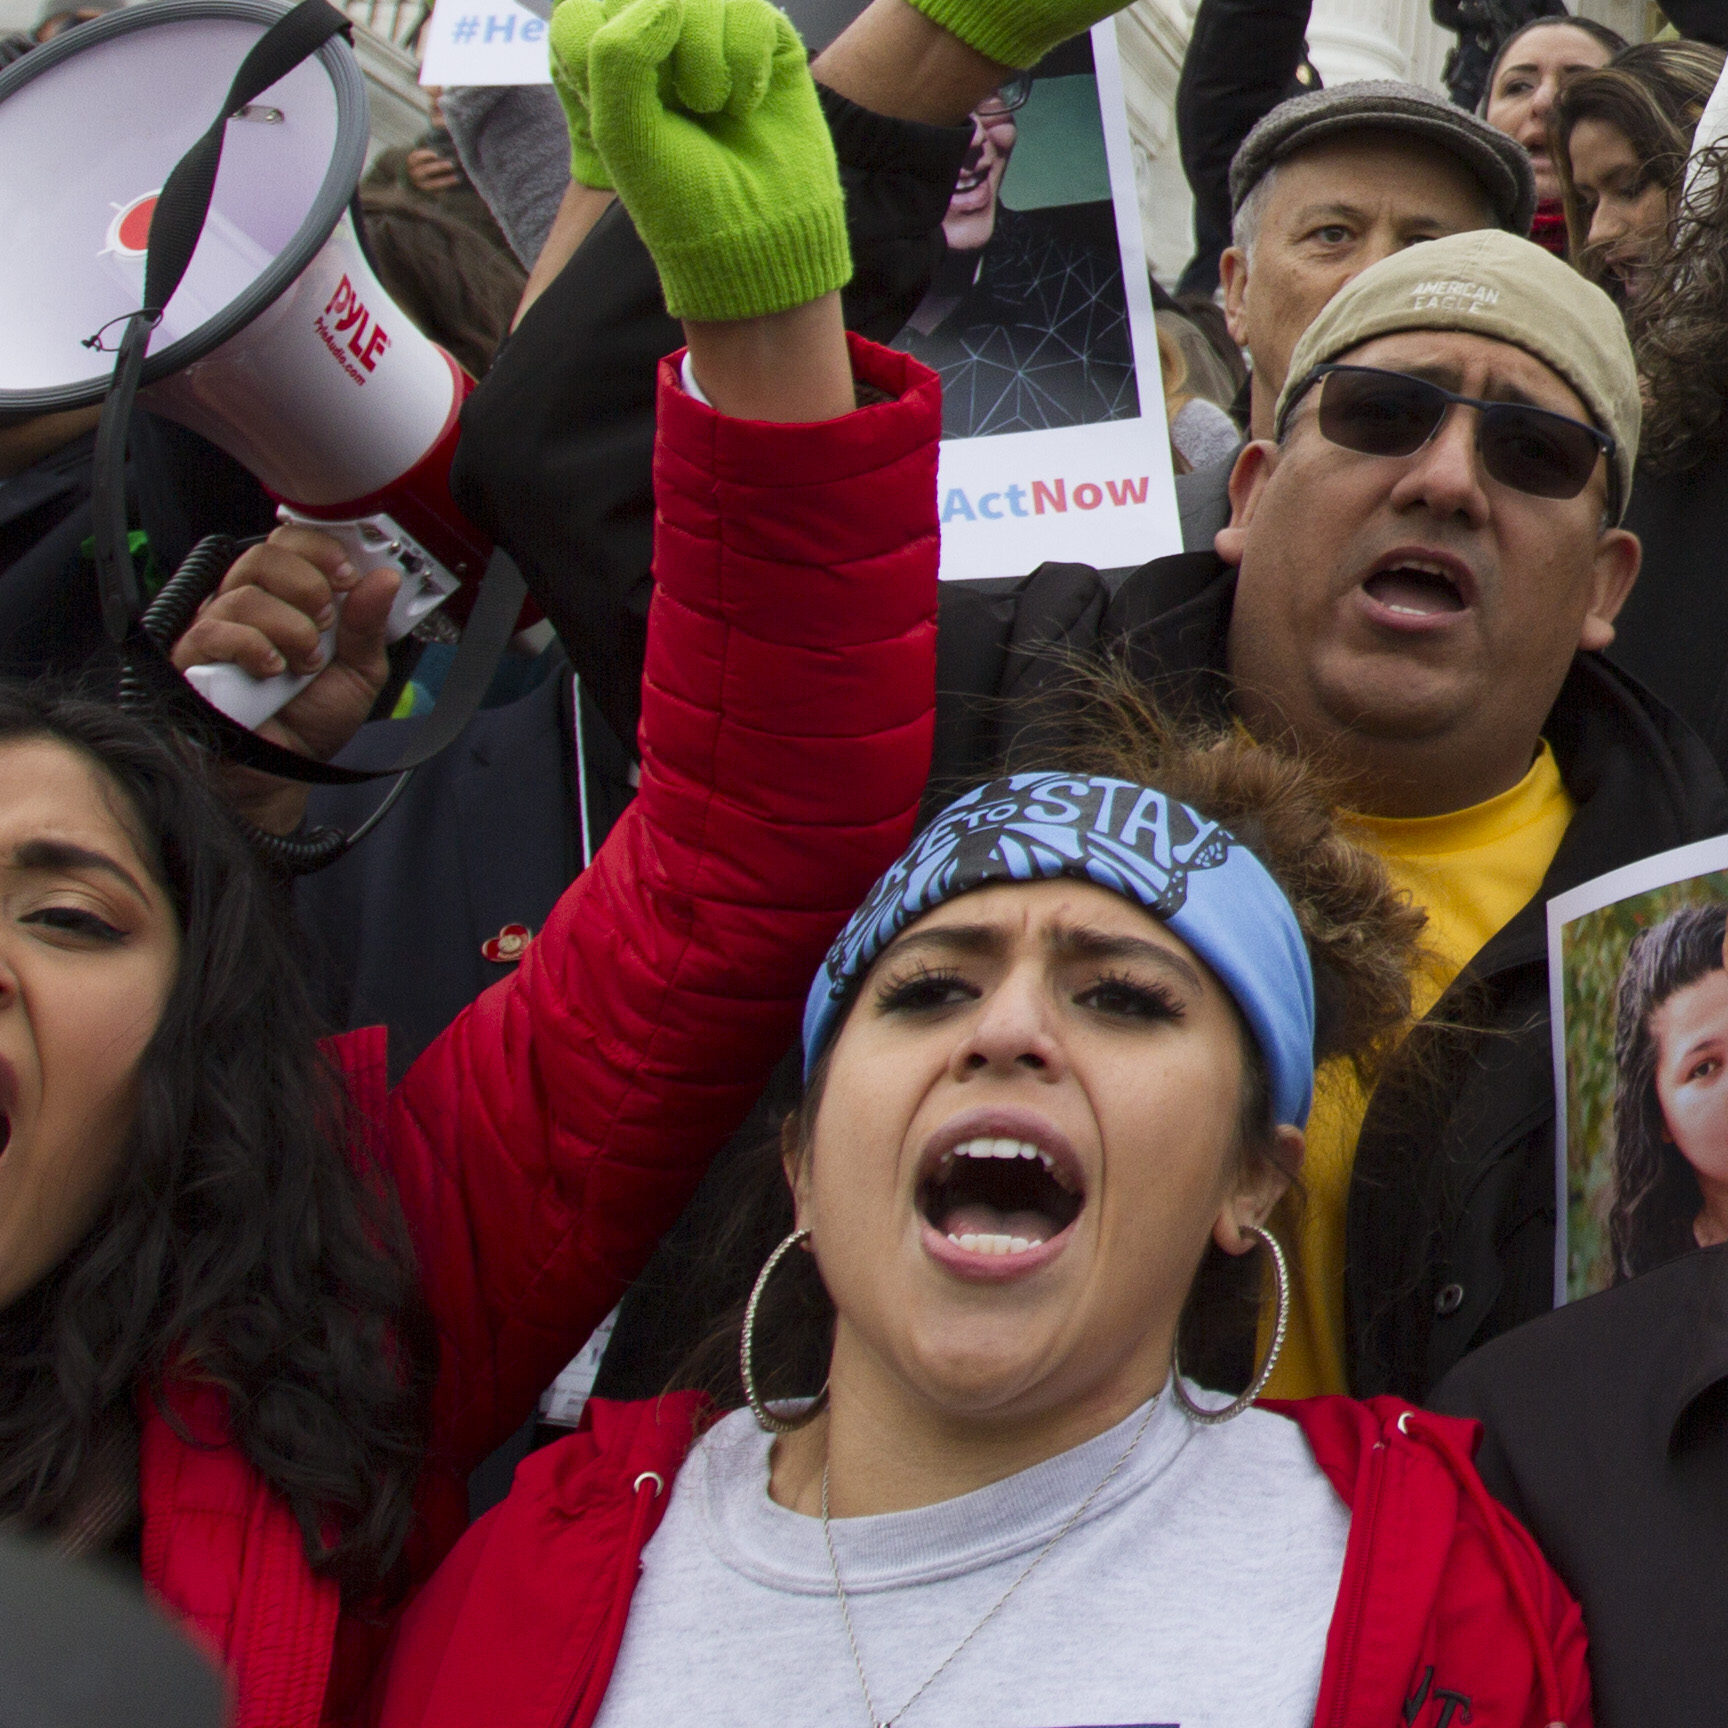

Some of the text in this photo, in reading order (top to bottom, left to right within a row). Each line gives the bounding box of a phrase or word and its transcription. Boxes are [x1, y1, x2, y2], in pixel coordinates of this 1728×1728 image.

[1412, 280, 1500, 305] AMERICAN
[1413, 296, 1484, 315] EAGLE
[313, 316, 367, 387] PyleAudio.com
[324, 273, 392, 374] PYLE
[941, 476, 1150, 524] ActNow
[963, 803, 1019, 827] TO
[1023, 775, 1219, 870] STAY
